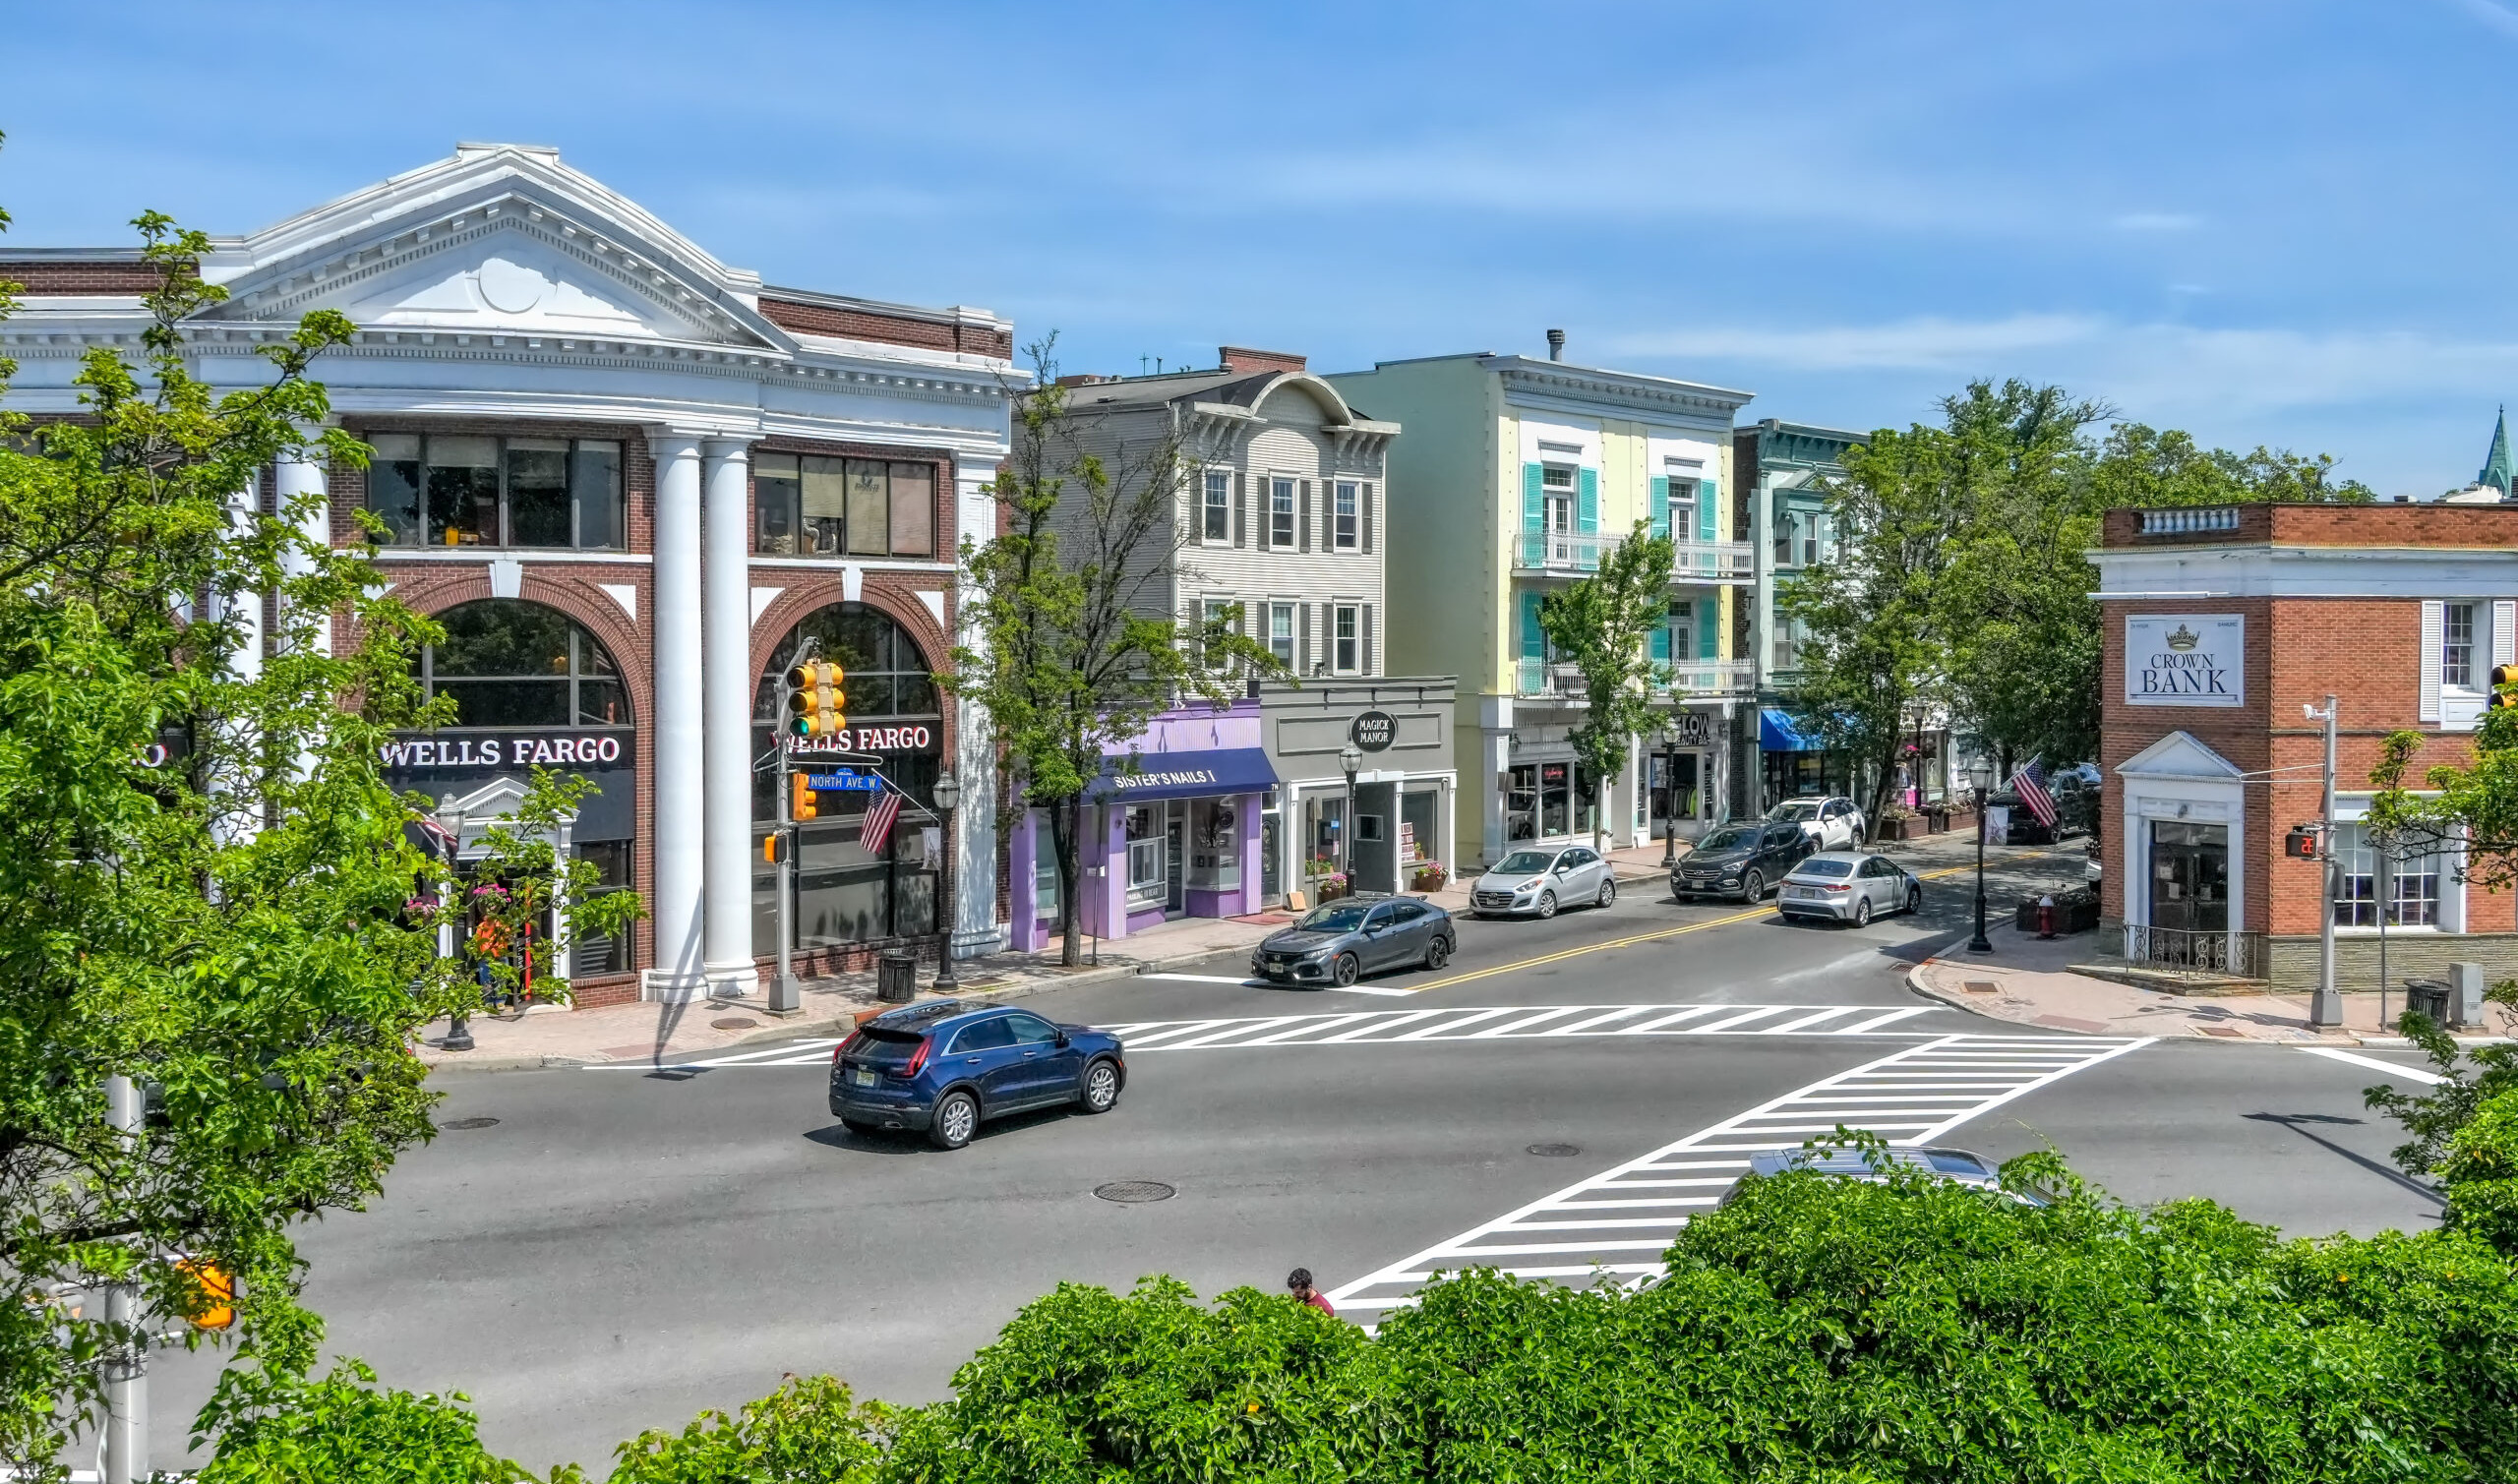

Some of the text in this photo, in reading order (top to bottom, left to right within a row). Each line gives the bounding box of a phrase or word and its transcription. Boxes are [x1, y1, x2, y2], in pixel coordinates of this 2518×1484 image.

[2151, 653, 2215, 670] CROWN
[2141, 669, 2228, 694] BANK
[1358, 719, 1390, 731] MAGICK
[857, 726, 929, 750] FARGO
[1359, 732, 1390, 743] MANOR
[379, 737, 621, 767] WELLS FARGO
[810, 776, 842, 788] NORTH
[1113, 772, 1171, 789] SISTER'S
[1169, 770, 1207, 785] NAILS
